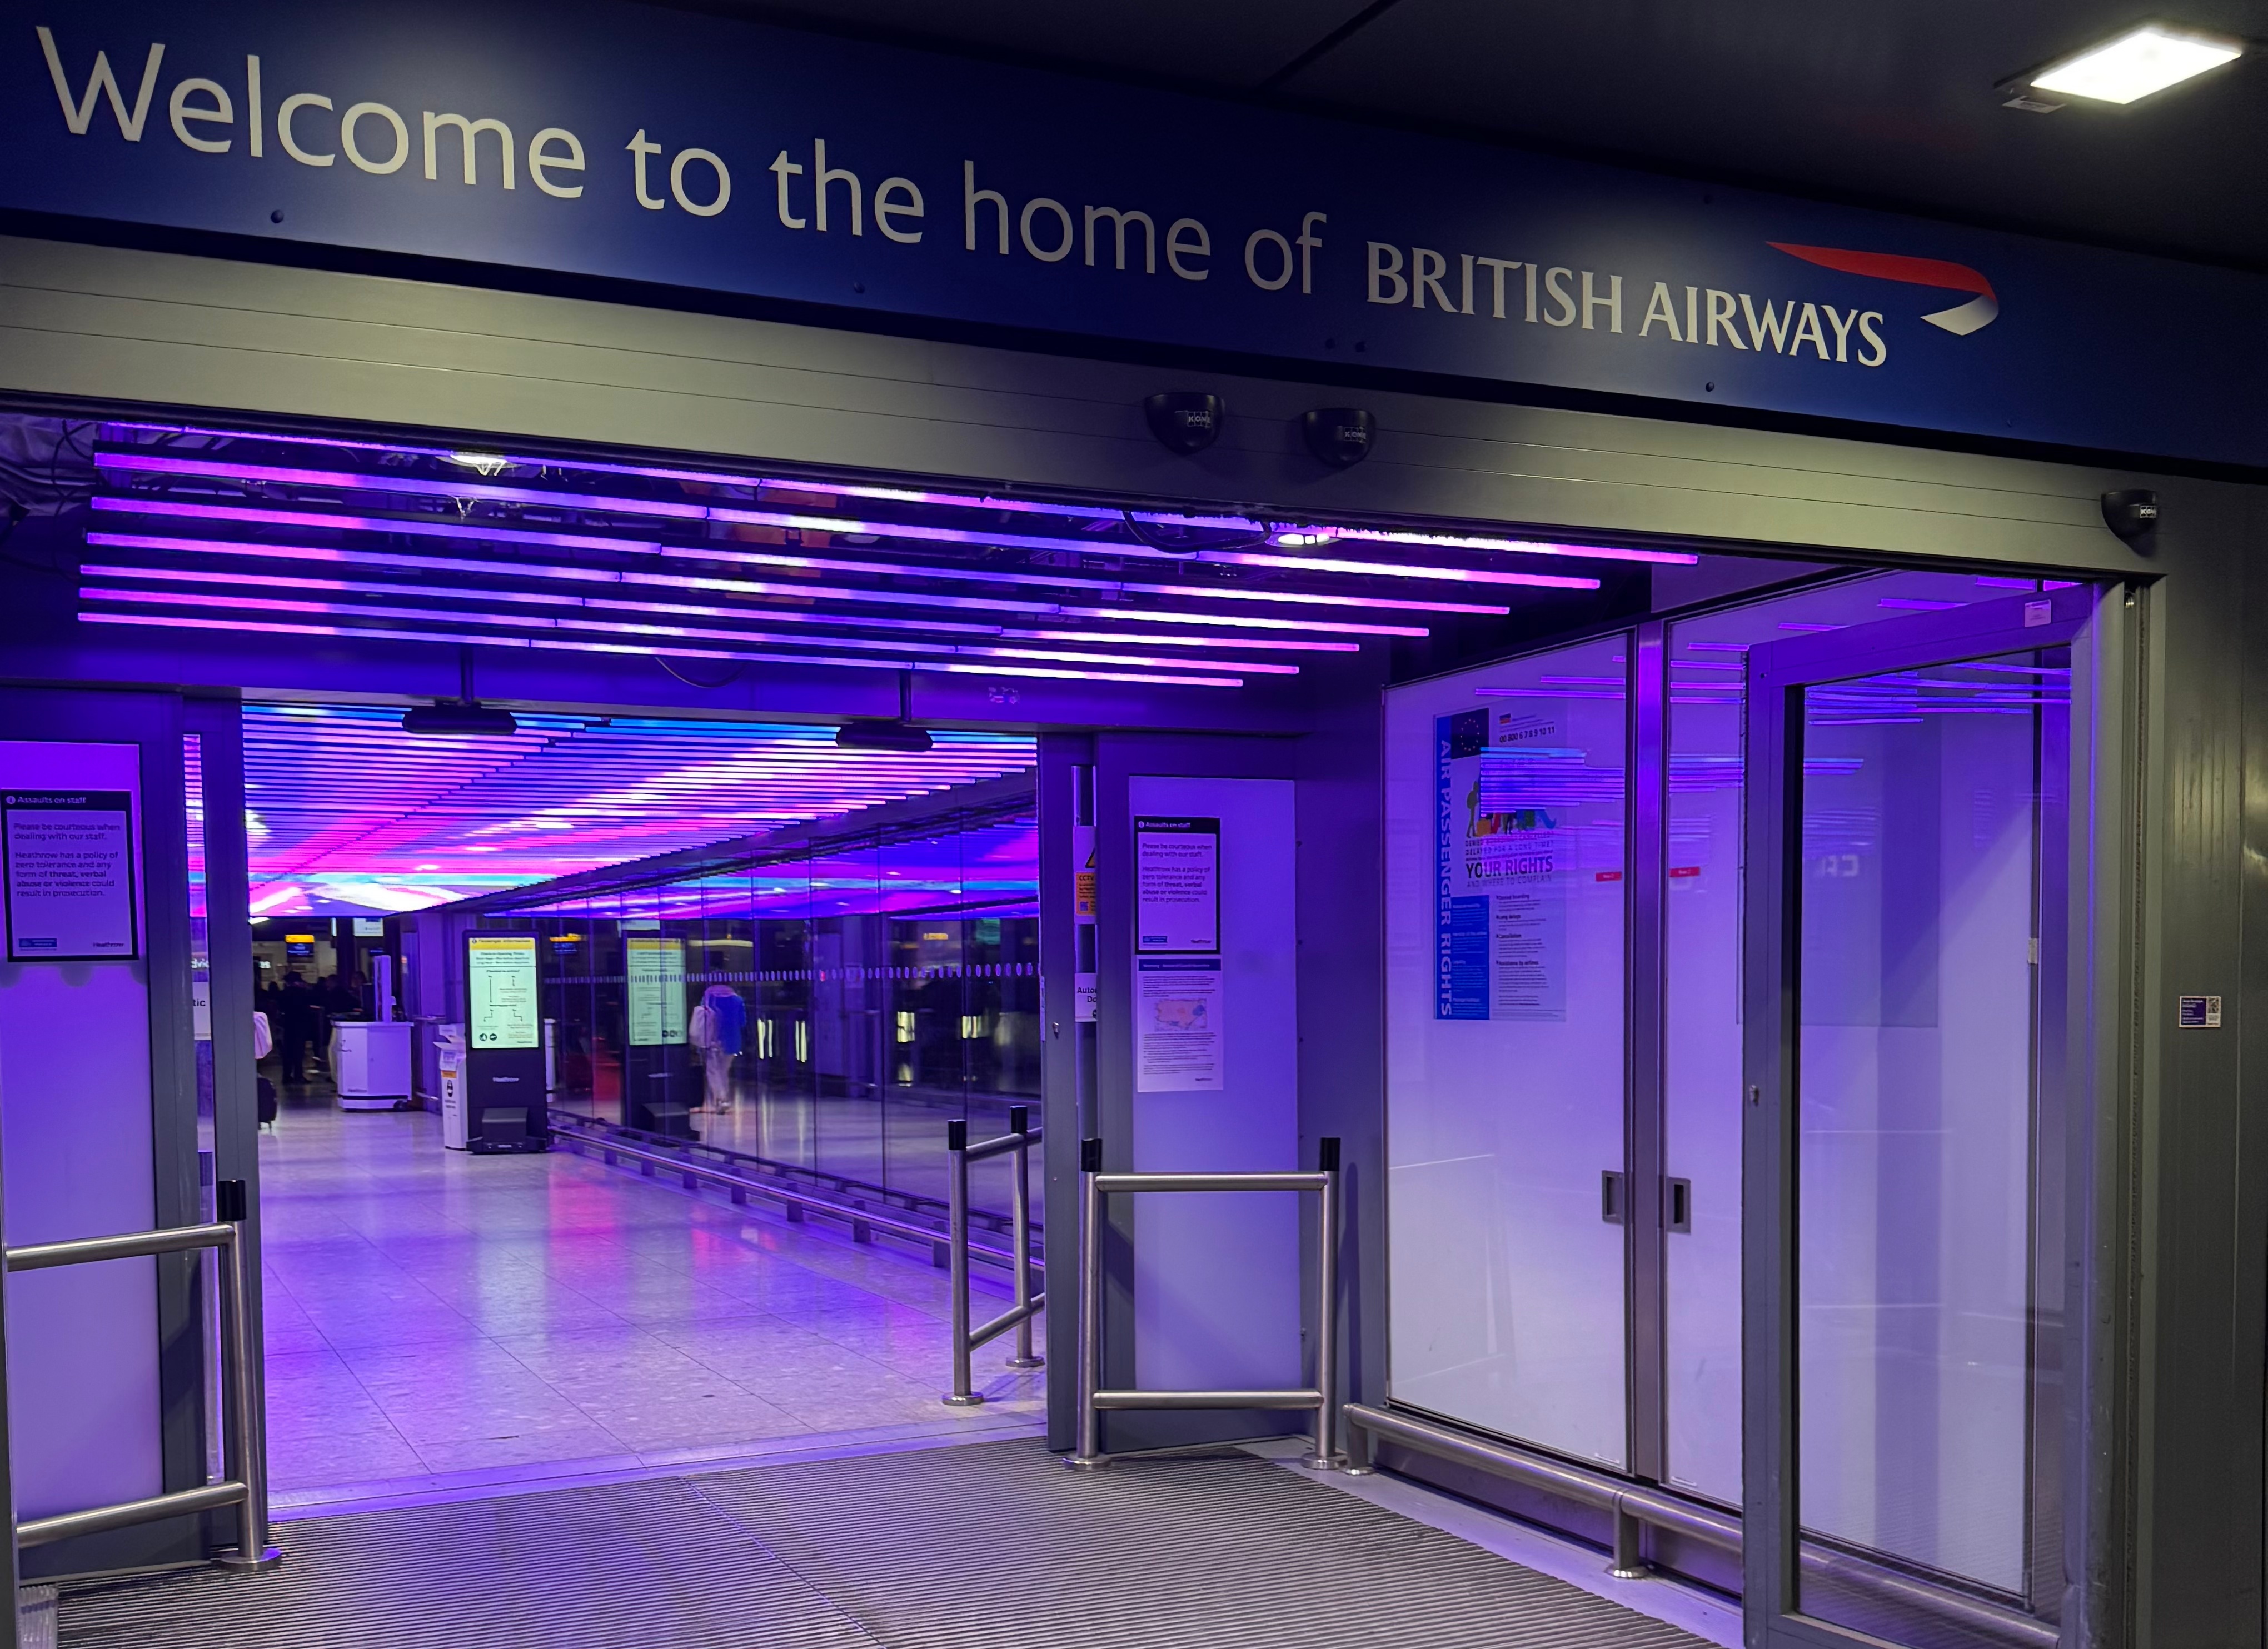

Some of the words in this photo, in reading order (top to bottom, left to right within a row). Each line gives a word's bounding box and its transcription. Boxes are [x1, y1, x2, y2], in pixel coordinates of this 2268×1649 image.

[36, 26, 586, 199] Welcome
[625, 128, 731, 216] to
[769, 138, 925, 243] the
[963, 159, 1211, 281] home
[1244, 211, 1327, 294] of
[1366, 240, 1624, 334] BRITISH
[1638, 281, 1887, 367] AIRWAYS
[1441, 739, 1451, 779] AIR
[14, 833, 46, 841] dealing
[83, 851, 107, 860] policy
[1441, 787, 1452, 925] PASSENGER
[1466, 860, 1502, 878] YOUR
[1505, 855, 1553, 876] RIGHTS
[1441, 933, 1452, 1015] RIGHTS
